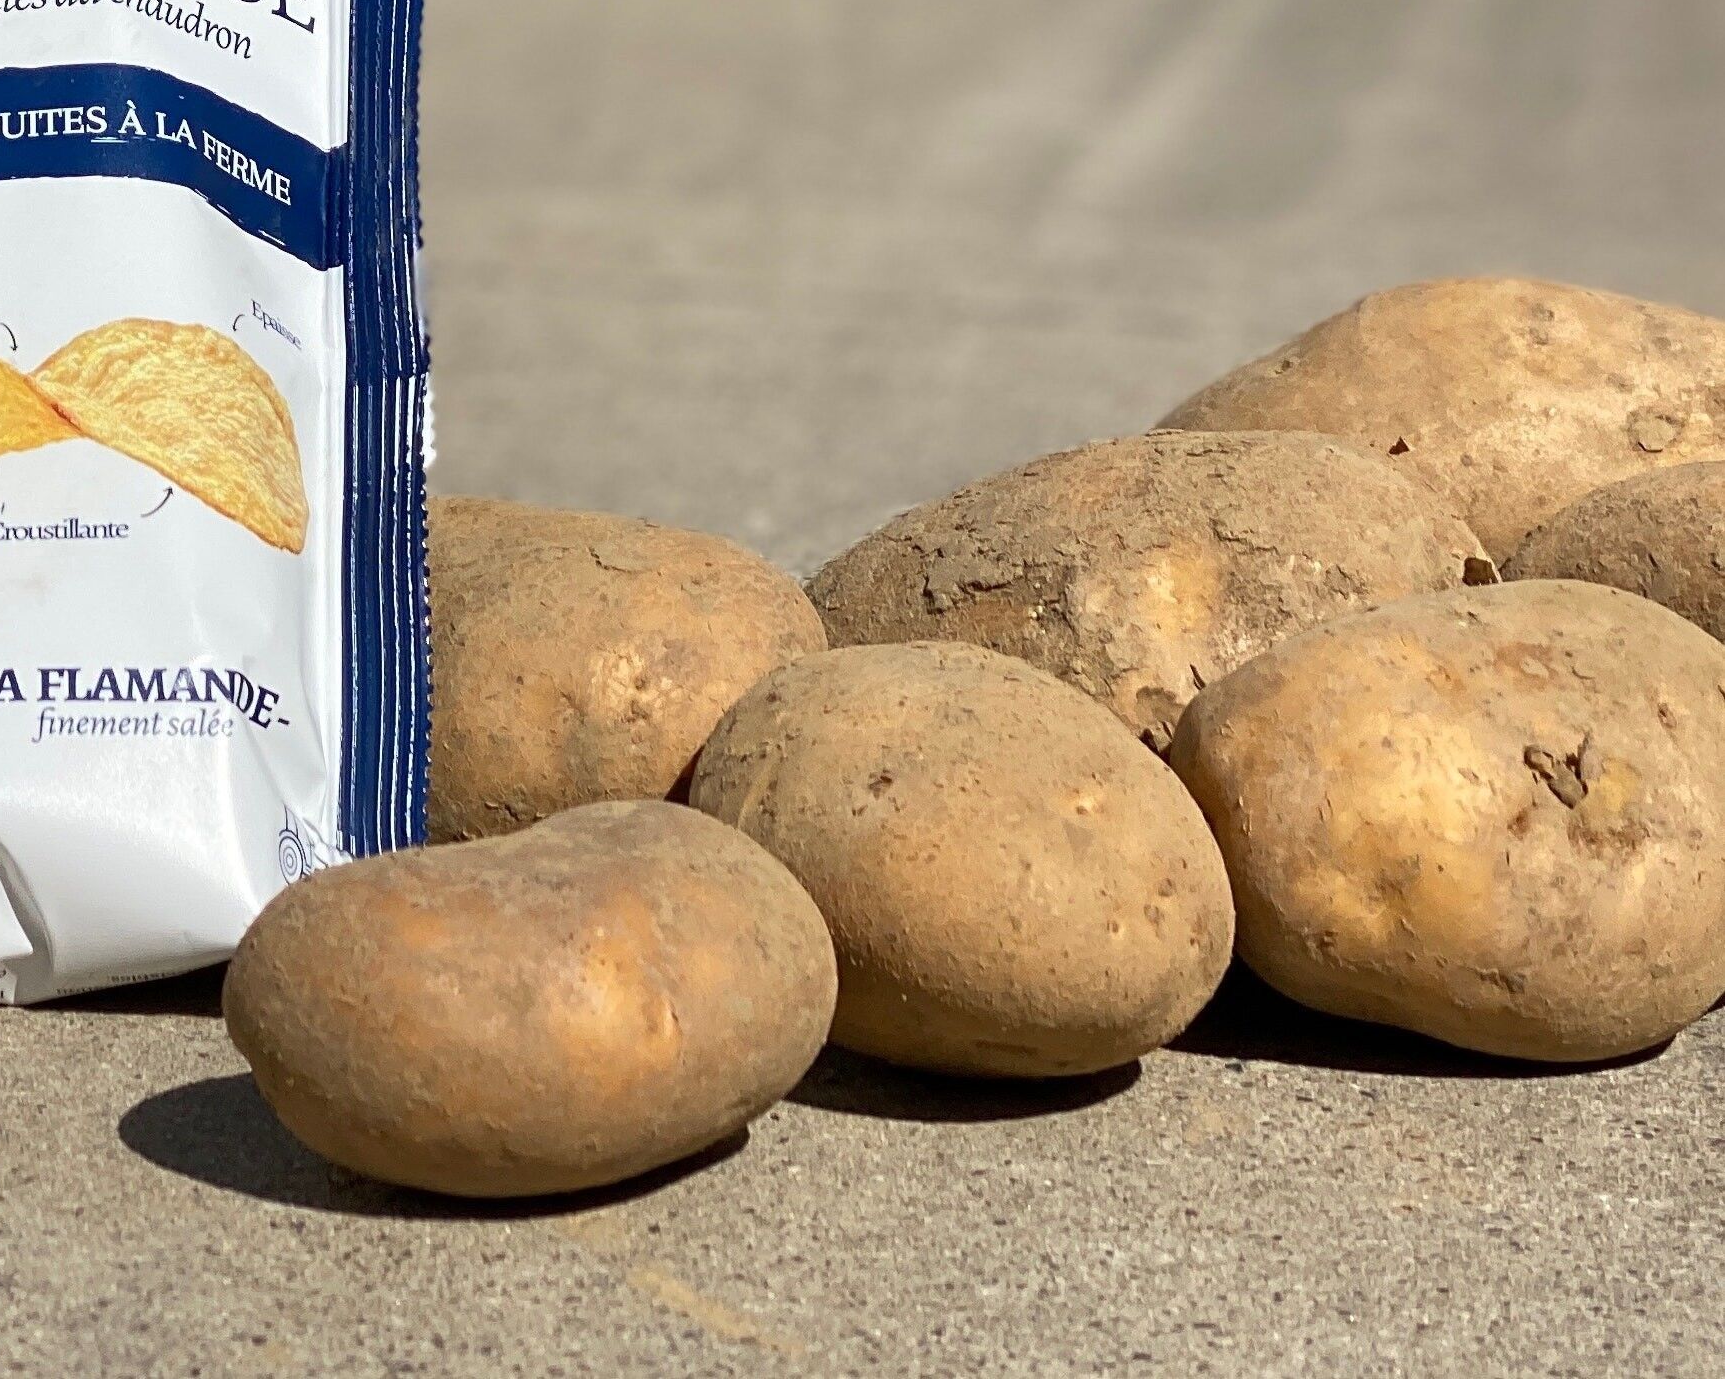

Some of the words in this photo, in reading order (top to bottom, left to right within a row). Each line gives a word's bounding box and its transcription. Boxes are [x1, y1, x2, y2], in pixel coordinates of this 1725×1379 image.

[118, 99, 147, 136] À
[156, 111, 197, 150] LA
[203, 131, 292, 206] FERME
[32, 706, 162, 743] finement
[166, 708, 234, 738] salée
